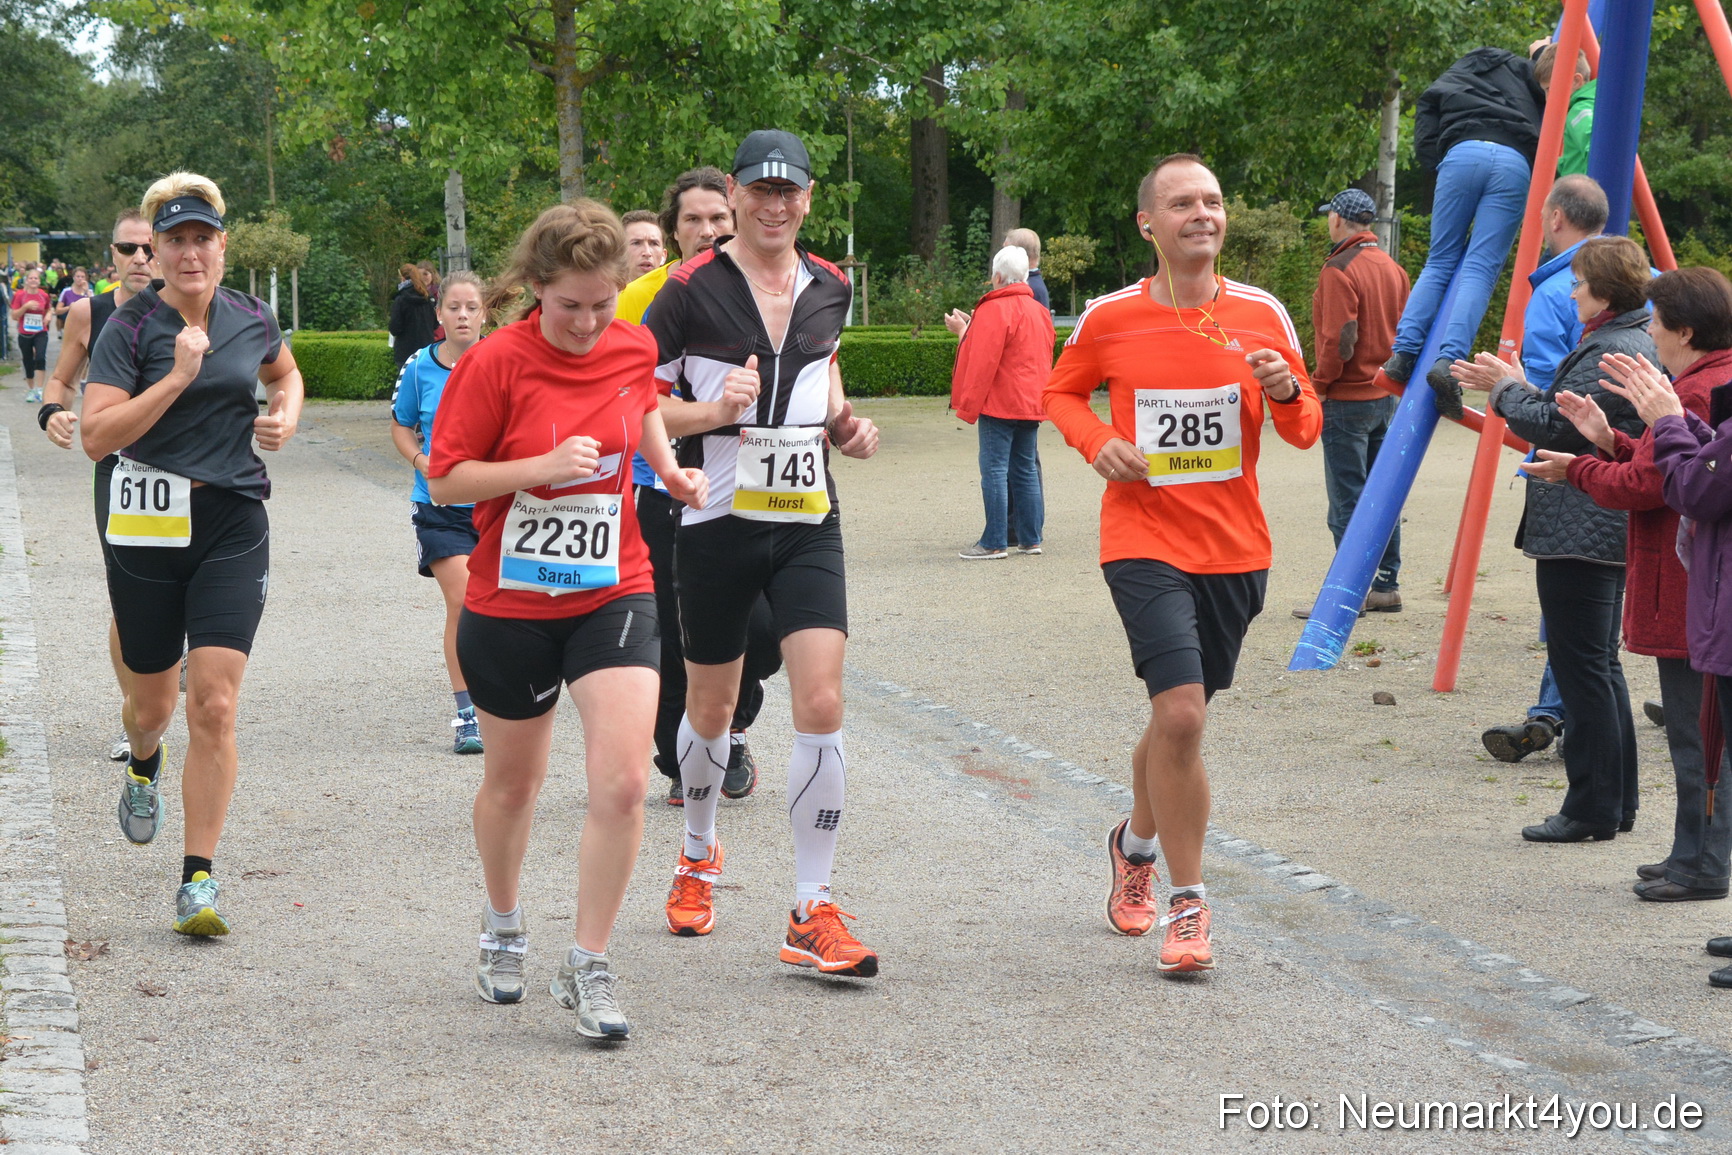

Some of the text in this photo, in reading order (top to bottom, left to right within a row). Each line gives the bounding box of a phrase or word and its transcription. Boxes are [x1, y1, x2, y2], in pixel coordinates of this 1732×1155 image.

[1137, 397, 1225, 408] PARTL Neumarkt
[1158, 411, 1224, 448] 285
[760, 451, 816, 488] 143
[1169, 455, 1213, 471] Marko
[120, 476, 171, 512] 610
[768, 495, 805, 510] Horst
[513, 501, 605, 515] PARTL Neumarkt
[514, 516, 610, 560] 2230
[537, 566, 582, 585] Sarah
[814, 822, 838, 832] cep
